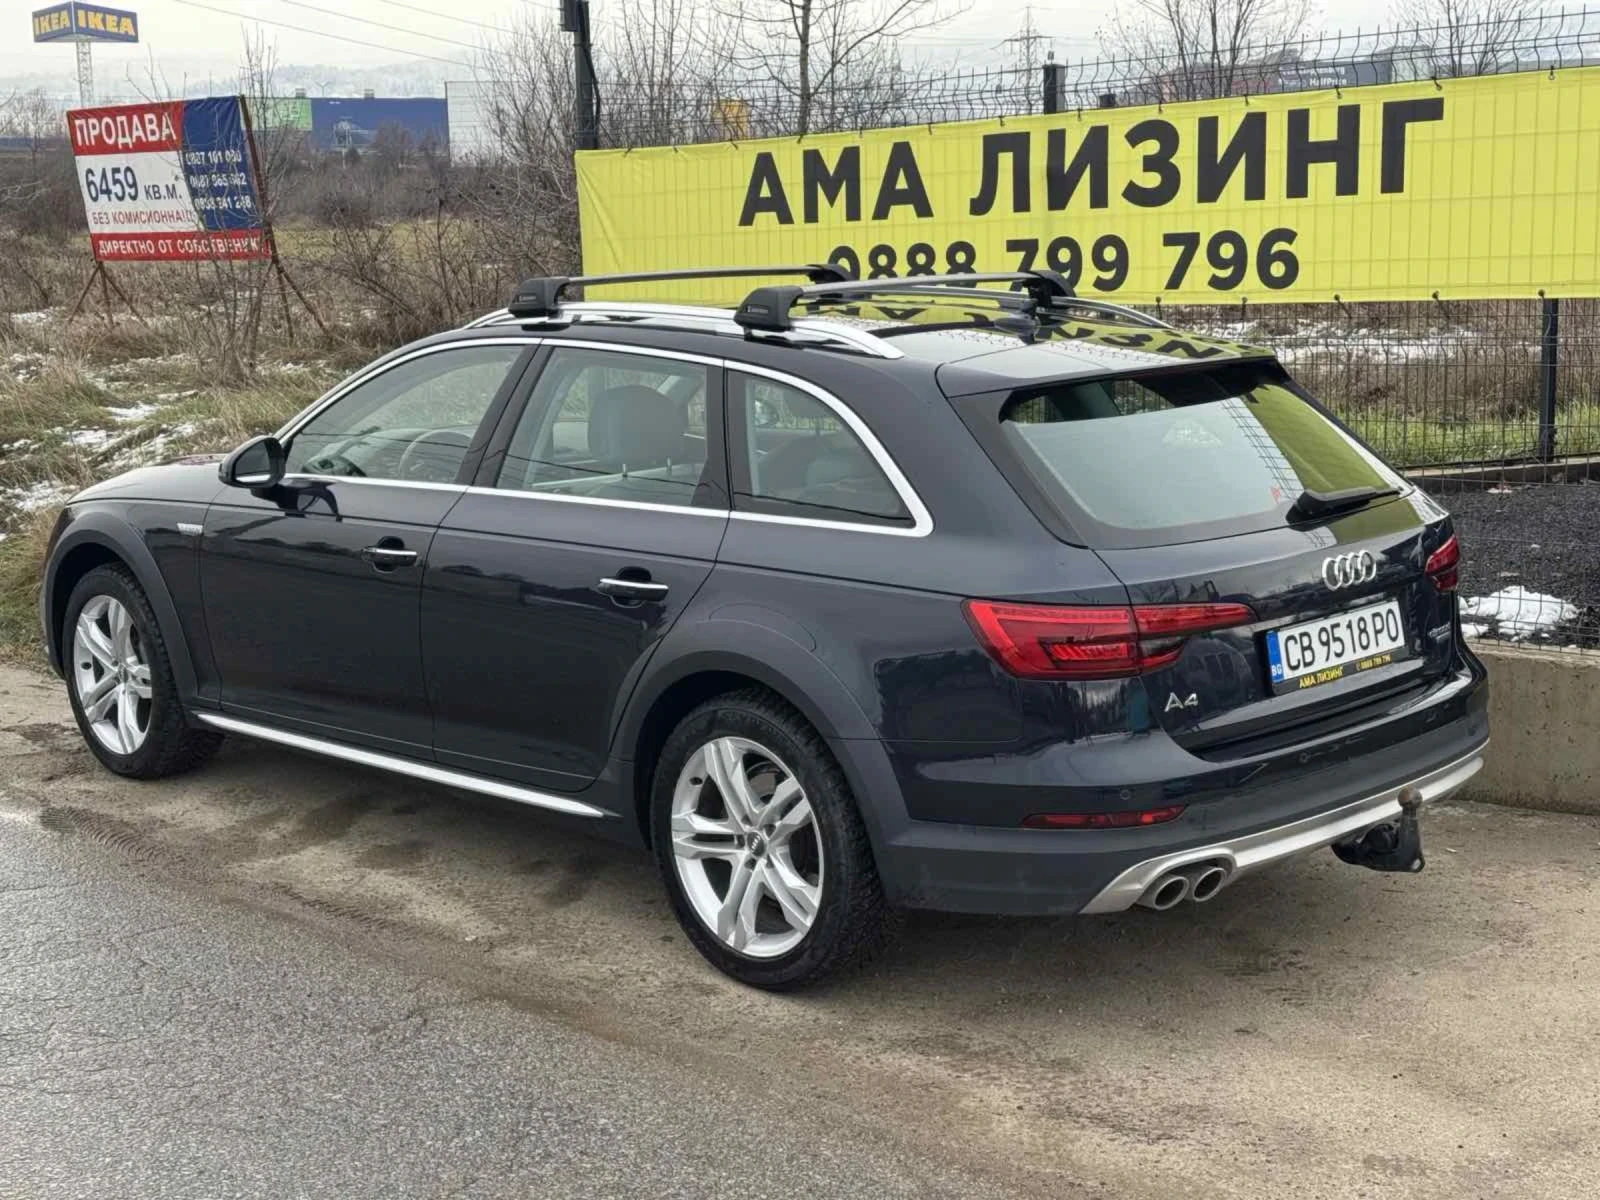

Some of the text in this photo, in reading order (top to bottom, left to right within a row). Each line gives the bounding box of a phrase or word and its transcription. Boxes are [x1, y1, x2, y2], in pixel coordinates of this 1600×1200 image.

[34, 10, 71, 35] IKEA
[77, 9, 136, 36] IKEA
[74, 111, 177, 149] ПРОДАВА
[738, 97, 1445, 226] АМА ЛИЗИНГ
[85, 166, 182, 202] 6459 КВ.М.
[92, 211, 111, 225] БЕЗ
[98, 239, 156, 257] ДИРЕКТНО
[158, 239, 174, 254] ОТ
[828, 228, 1300, 292] 0888 799 796
[1317, 616, 1371, 663] 9518
[1271, 664, 1283, 677] BG
[1164, 692, 1199, 712] A4
